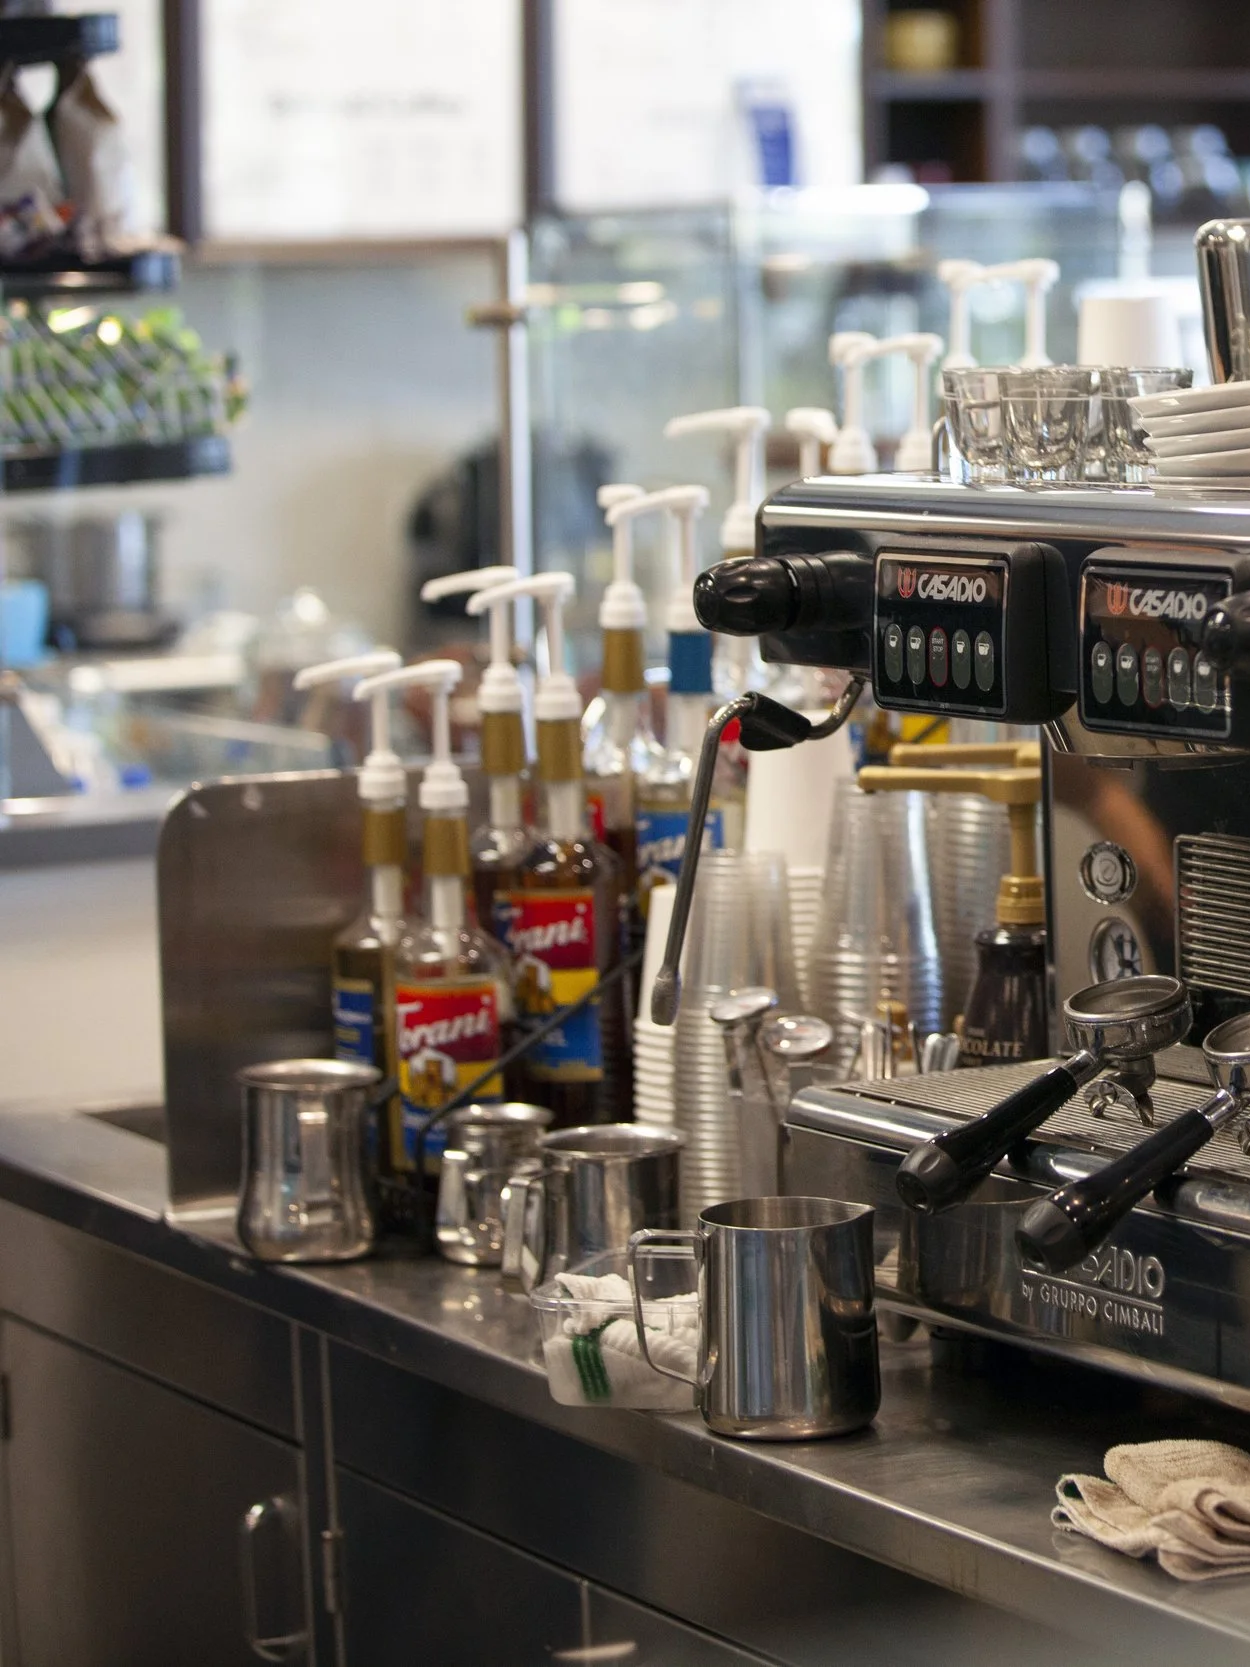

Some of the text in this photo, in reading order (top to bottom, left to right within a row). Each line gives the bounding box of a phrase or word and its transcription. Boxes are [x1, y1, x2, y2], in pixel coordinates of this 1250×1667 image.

[918, 574, 986, 602] CASADIO
[1129, 589, 1207, 619] CASADIO
[1021, 1280, 1164, 1336] by GRUPPO CIMBALI
